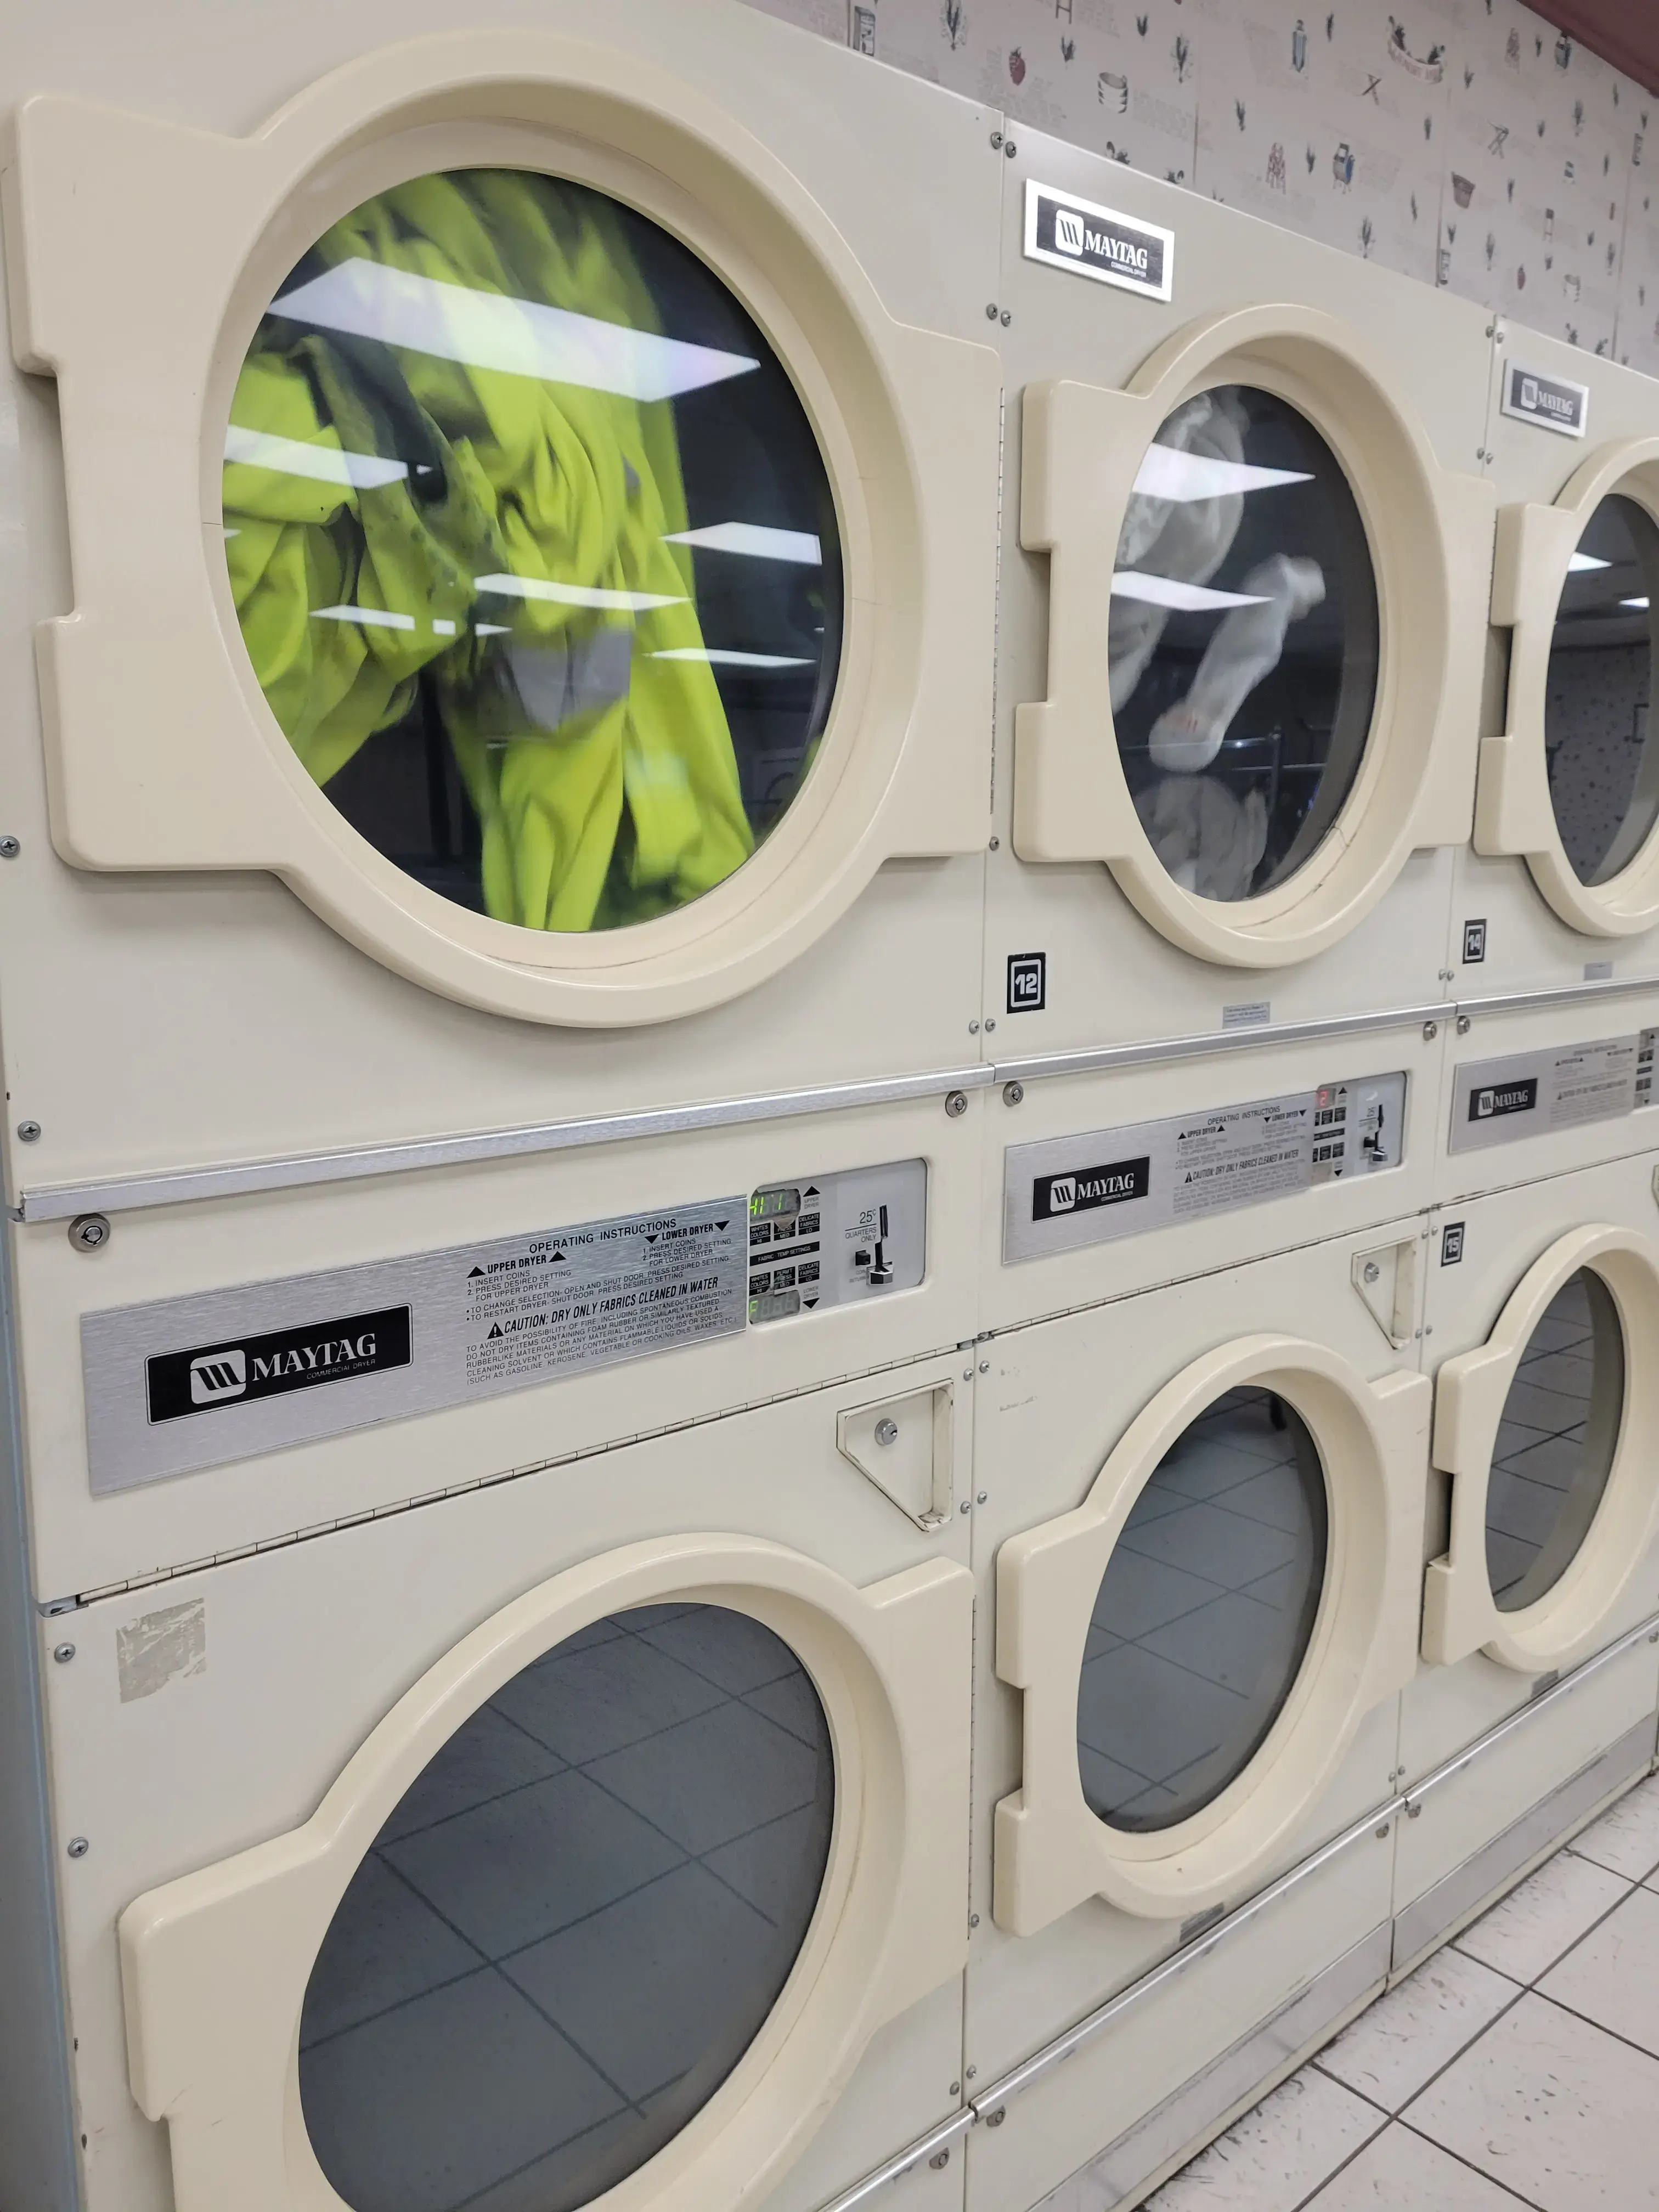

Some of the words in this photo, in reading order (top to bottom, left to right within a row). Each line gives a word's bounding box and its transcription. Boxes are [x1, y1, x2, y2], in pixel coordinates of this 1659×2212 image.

[1085, 229, 1148, 269] MAYTAG
[1537, 391, 1573, 416] MAYTAG
[1469, 934, 1481, 950] 14
[1015, 973, 1037, 995] 12
[1493, 1090, 1528, 1108] MAYTAG
[1207, 1113, 1239, 1125] OPERATING
[1242, 1106, 1280, 1119] INSTRUCTIONS
[1272, 1113, 1285, 1121] LOWER
[1187, 1128, 1201, 1137] UPPER
[1202, 1126, 1216, 1135] DRYER
[1215, 1167, 1225, 1175] DRY
[1226, 1163, 1238, 1173] ONLY
[1239, 1158, 1257, 1170] FABRICS
[1258, 1154, 1278, 1166] CLEANED
[1284, 1149, 1299, 1159] WATER
[1077, 1173, 1134, 1200] MAYTAG
[799, 1214, 819, 1222] DELICATE
[529, 1234, 594, 1253] OPERATING
[600, 1218, 676, 1240] INSTRUCTIONS
[662, 1228, 687, 1241] LOWER
[690, 1223, 713, 1234] DRYER
[845, 1227, 877, 1239] QUARTERS
[861, 1234, 876, 1242] ONLY
[649, 1243, 674, 1252] INSERT
[676, 1238, 696, 1248] COINS
[650, 1250, 671, 1260] PRESS
[674, 1244, 702, 1254] DESIRED
[704, 1238, 731, 1248] SETTING
[790, 1246, 811, 1255] SETTINGS
[1448, 1237, 1459, 1253] 15
[488, 1261, 516, 1274] UPPER
[519, 1255, 546, 1268] DRYER
[665, 1254, 689, 1263] LOWER
[691, 1249, 713, 1259] DRYER
[799, 1262, 819, 1271] DELICATE
[476, 1276, 503, 1286] INSERT
[506, 1271, 530, 1280] COINS
[476, 1283, 501, 1294] PRESS
[505, 1277, 537, 1288] DESIRED
[540, 1269, 571, 1280] SETTING
[484, 1299, 515, 1310] CHANGE
[565, 1285, 584, 1294] OPEN
[603, 1277, 622, 1286] SHUT
[648, 1268, 670, 1277] PRESS
[672, 1262, 700, 1272] DESIRED
[702, 1255, 729, 1266] SETTING
[484, 1306, 518, 1318] RESTART
[552, 1295, 571, 1305] SHUT
[599, 1286, 621, 1295] PRESS
[624, 1278, 653, 1289] DESIRED
[655, 1272, 683, 1283] SETTING
[495, 1287, 523, 1297] UPPER
[523, 1282, 548, 1292] DRYER
[505, 1313, 549, 1333] CAUTION:
[551, 1308, 572, 1323] DRY
[574, 1302, 597, 1318] ONLY
[600, 1294, 635, 1312] FABRICS
[639, 1285, 676, 1304] CLEANED
[679, 1284, 687, 1295] IN
[690, 1277, 718, 1293] WATER
[479, 1340, 503, 1350] AVOID
[522, 1325, 566, 1340] POSSIBILITY
[601, 1310, 637, 1322] INCLUDING
[640, 1299, 689, 1313] SPONTANEOUS
[691, 1289, 732, 1302] COMBUSTION
[480, 1348, 496, 1357] NOT
[499, 1345, 514, 1353] DRY
[516, 1340, 539, 1349] ITEMS
[541, 1329, 585, 1344] CONTAINING
[588, 1324, 607, 1333] FOAM
[610, 1317, 636, 1328] RUBBER
[651, 1307, 684, 1319] SIMILARLY
[686, 1299, 719, 1311] TEXTURED
[467, 1352, 514, 1368] RUBBERLIKE
[516, 1343, 557, 1357] MATERIALS
[589, 1329, 622, 1340] MATERIAL
[637, 1319, 658, 1329] WHICH
[696, 1307, 712, 1316] USED
[467, 1363, 505, 1377] CLEANING
[508, 1354, 541, 1367] SOLVENT
[557, 1345, 580, 1355] WHICH
[583, 1338, 618, 1350] CONTAINS
[620, 1326, 659, 1341] FLAMMABLE
[661, 1322, 686, 1331] LIQUIDS
[700, 1312, 723, 1322] SOLIDS
[251, 1333, 376, 1381] MAYTAG
[467, 1375, 490, 1385] (SUCH
[590, 1341, 630, 1355] VEGETABLE
[644, 1331, 674, 1342] COOKING
[307, 1365, 350, 1380] COMMERCIAL
[353, 1359, 375, 1369] DRYER
